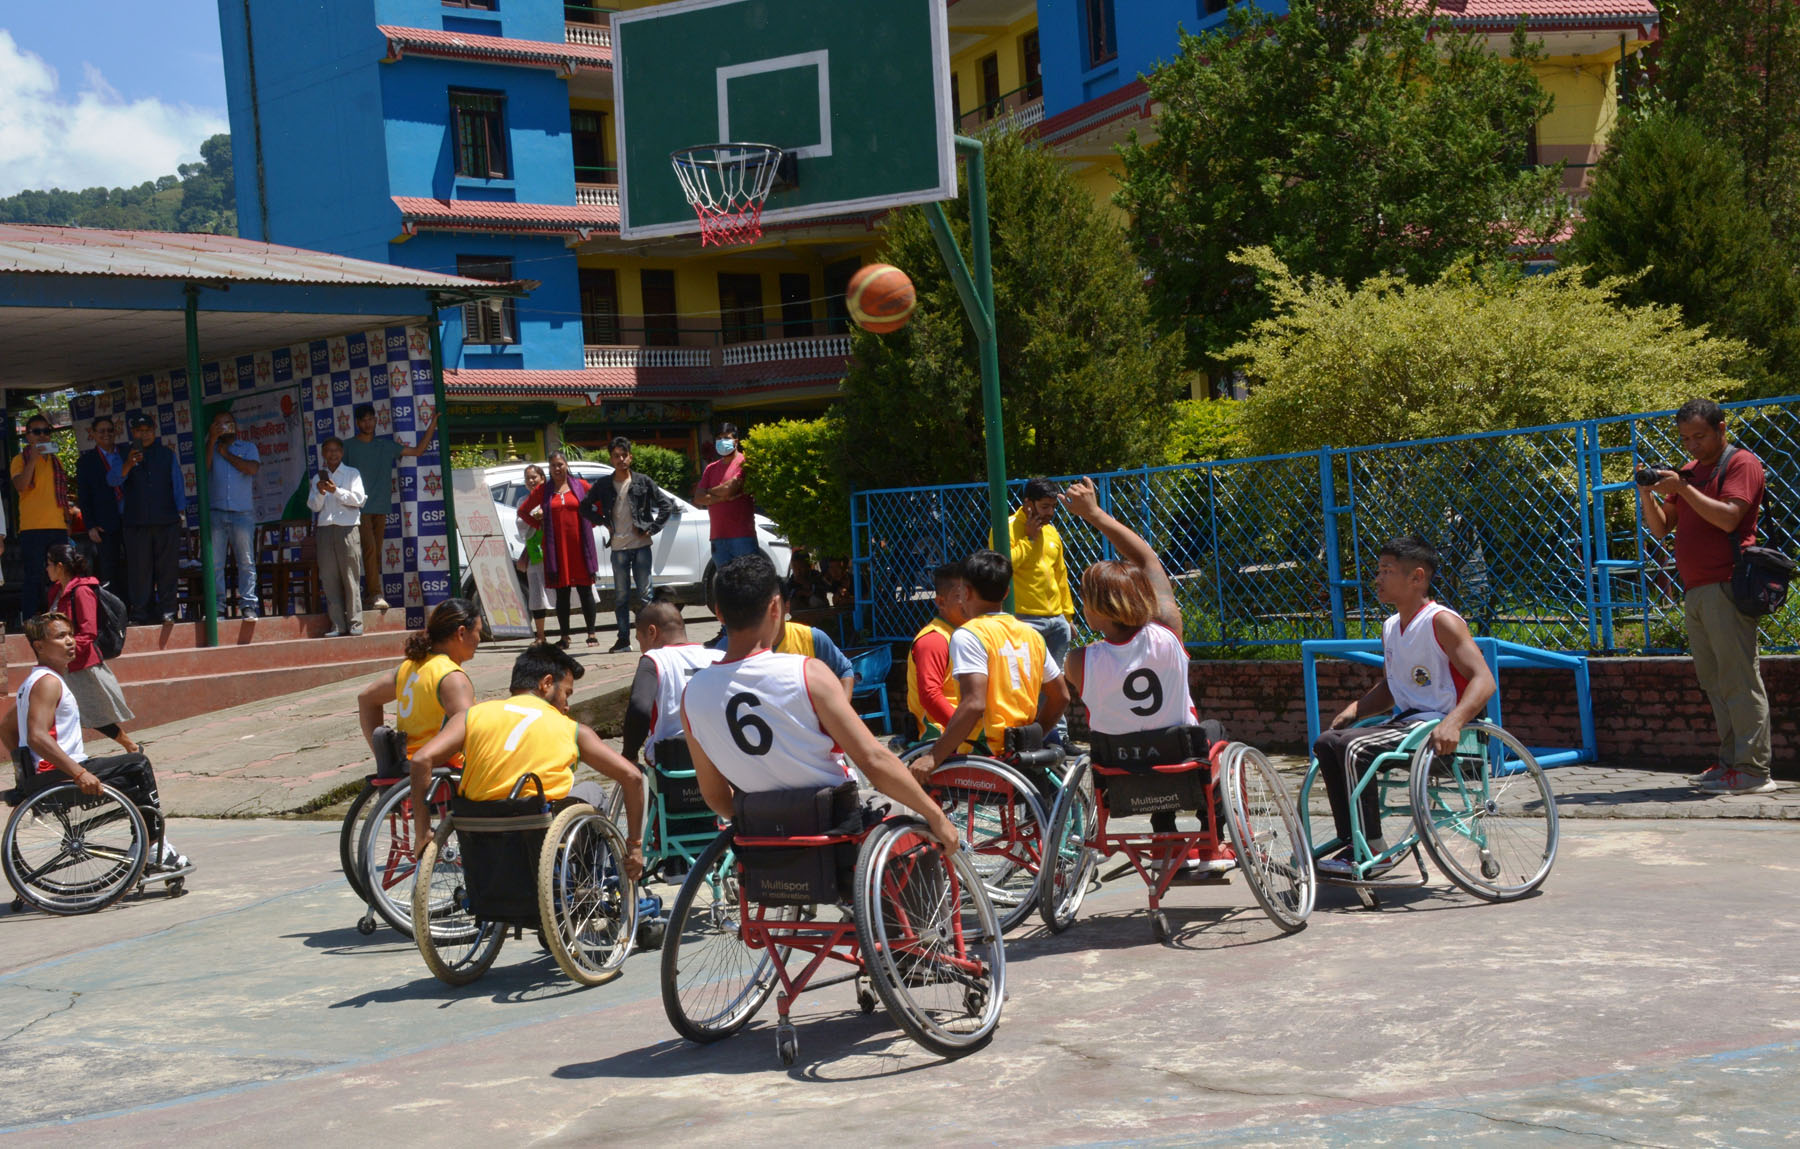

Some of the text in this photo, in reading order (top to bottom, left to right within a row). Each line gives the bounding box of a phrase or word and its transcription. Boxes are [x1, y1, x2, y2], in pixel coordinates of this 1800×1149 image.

[388, 335, 406, 347] GSP
[350, 343, 366, 355] GSP
[312, 350, 328, 361] GSP
[275, 358, 290, 369] GSP
[240, 364, 253, 376] GSP
[373, 374, 388, 386] GSP
[333, 381, 350, 392] GSP
[160, 412, 173, 423] GSP
[392, 406, 412, 417] SP
[317, 418, 332, 429] GSP
[426, 439, 440, 451] SP
[422, 509, 446, 522] GSP
[386, 583, 402, 594] GSP
[422, 580, 449, 592] GSP
[407, 616, 424, 627] GSP
[399, 671, 420, 719] 5
[1122, 667, 1164, 716] 9
[504, 703, 543, 752] 7
[725, 691, 774, 756] 6
[955, 777, 997, 790] motivation
[1129, 793, 1180, 806] Multisport
[761, 879, 809, 892] Multisport
